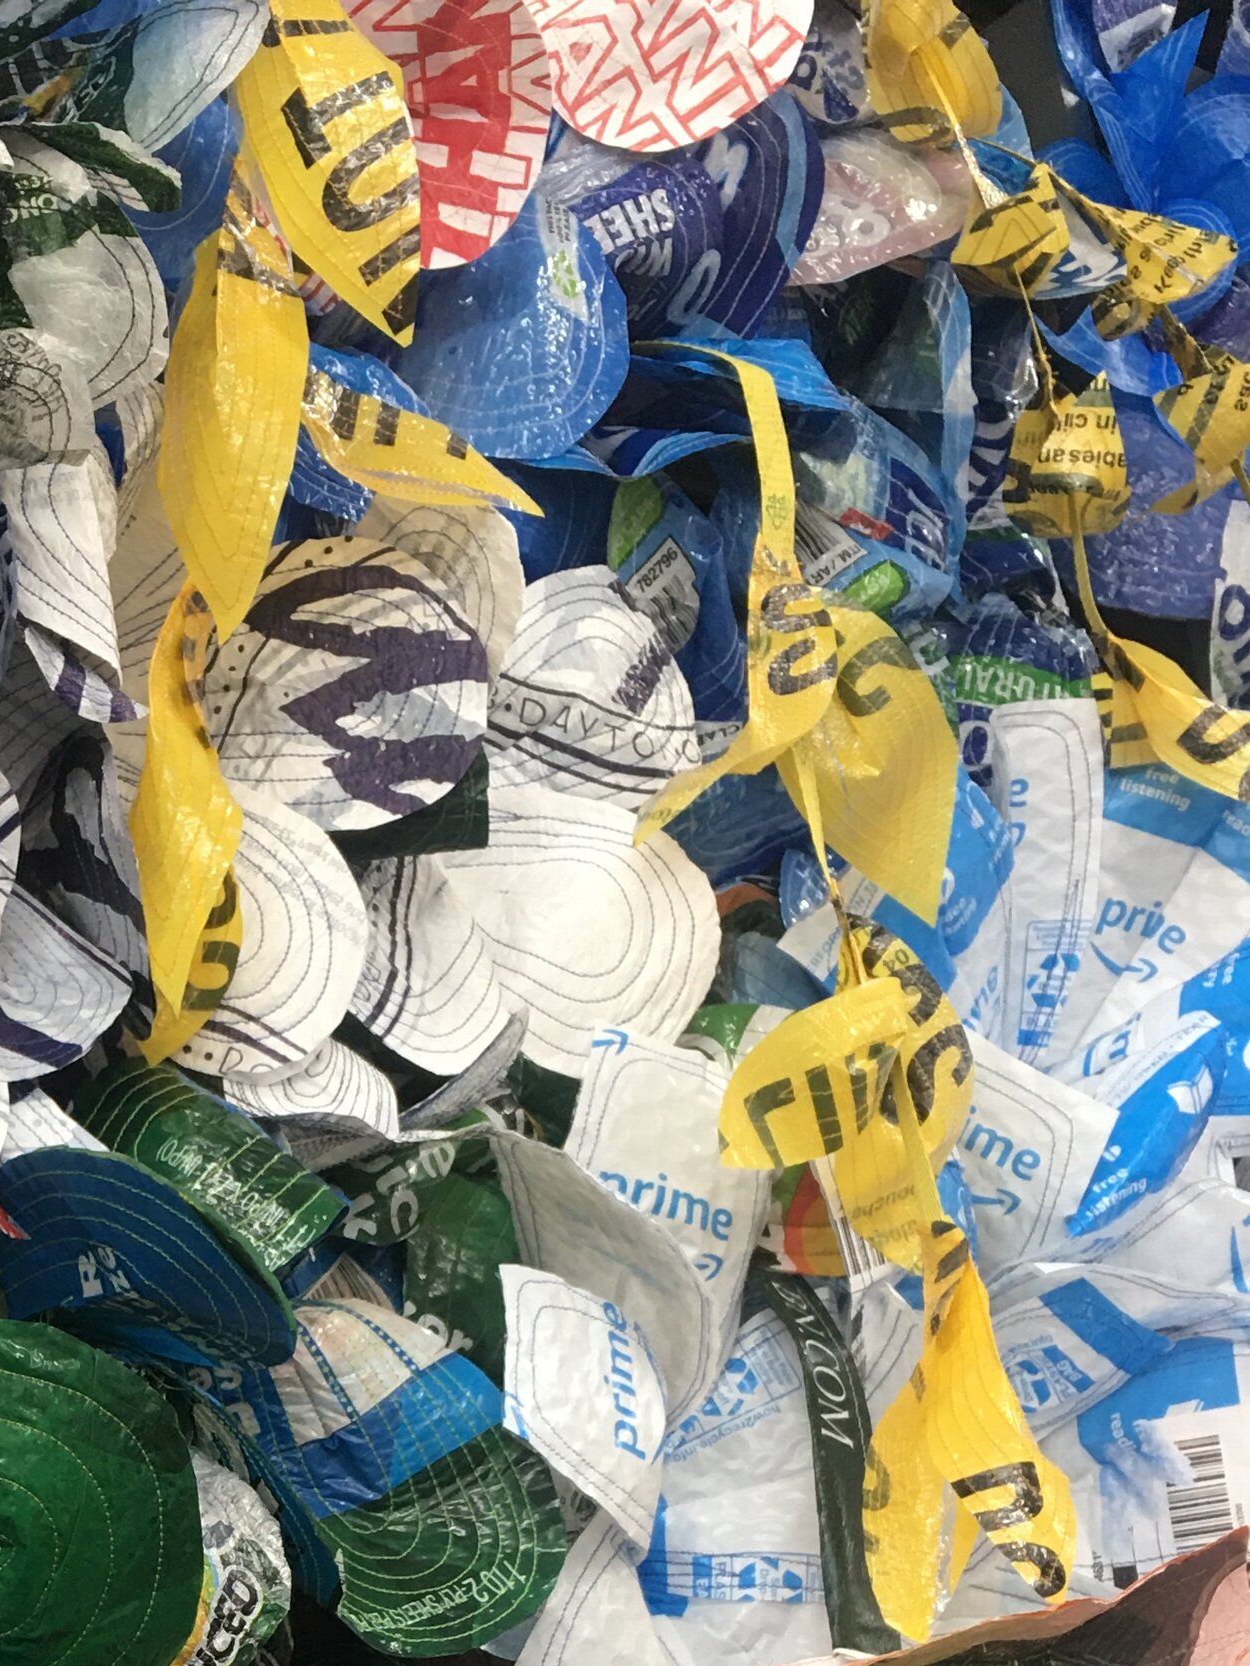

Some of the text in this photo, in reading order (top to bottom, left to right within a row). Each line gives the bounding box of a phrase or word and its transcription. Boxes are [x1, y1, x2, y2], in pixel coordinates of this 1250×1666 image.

[1119, 778, 1192, 811] listening
[599, 1170, 734, 1241] prime
[604, 1300, 647, 1461] prime
